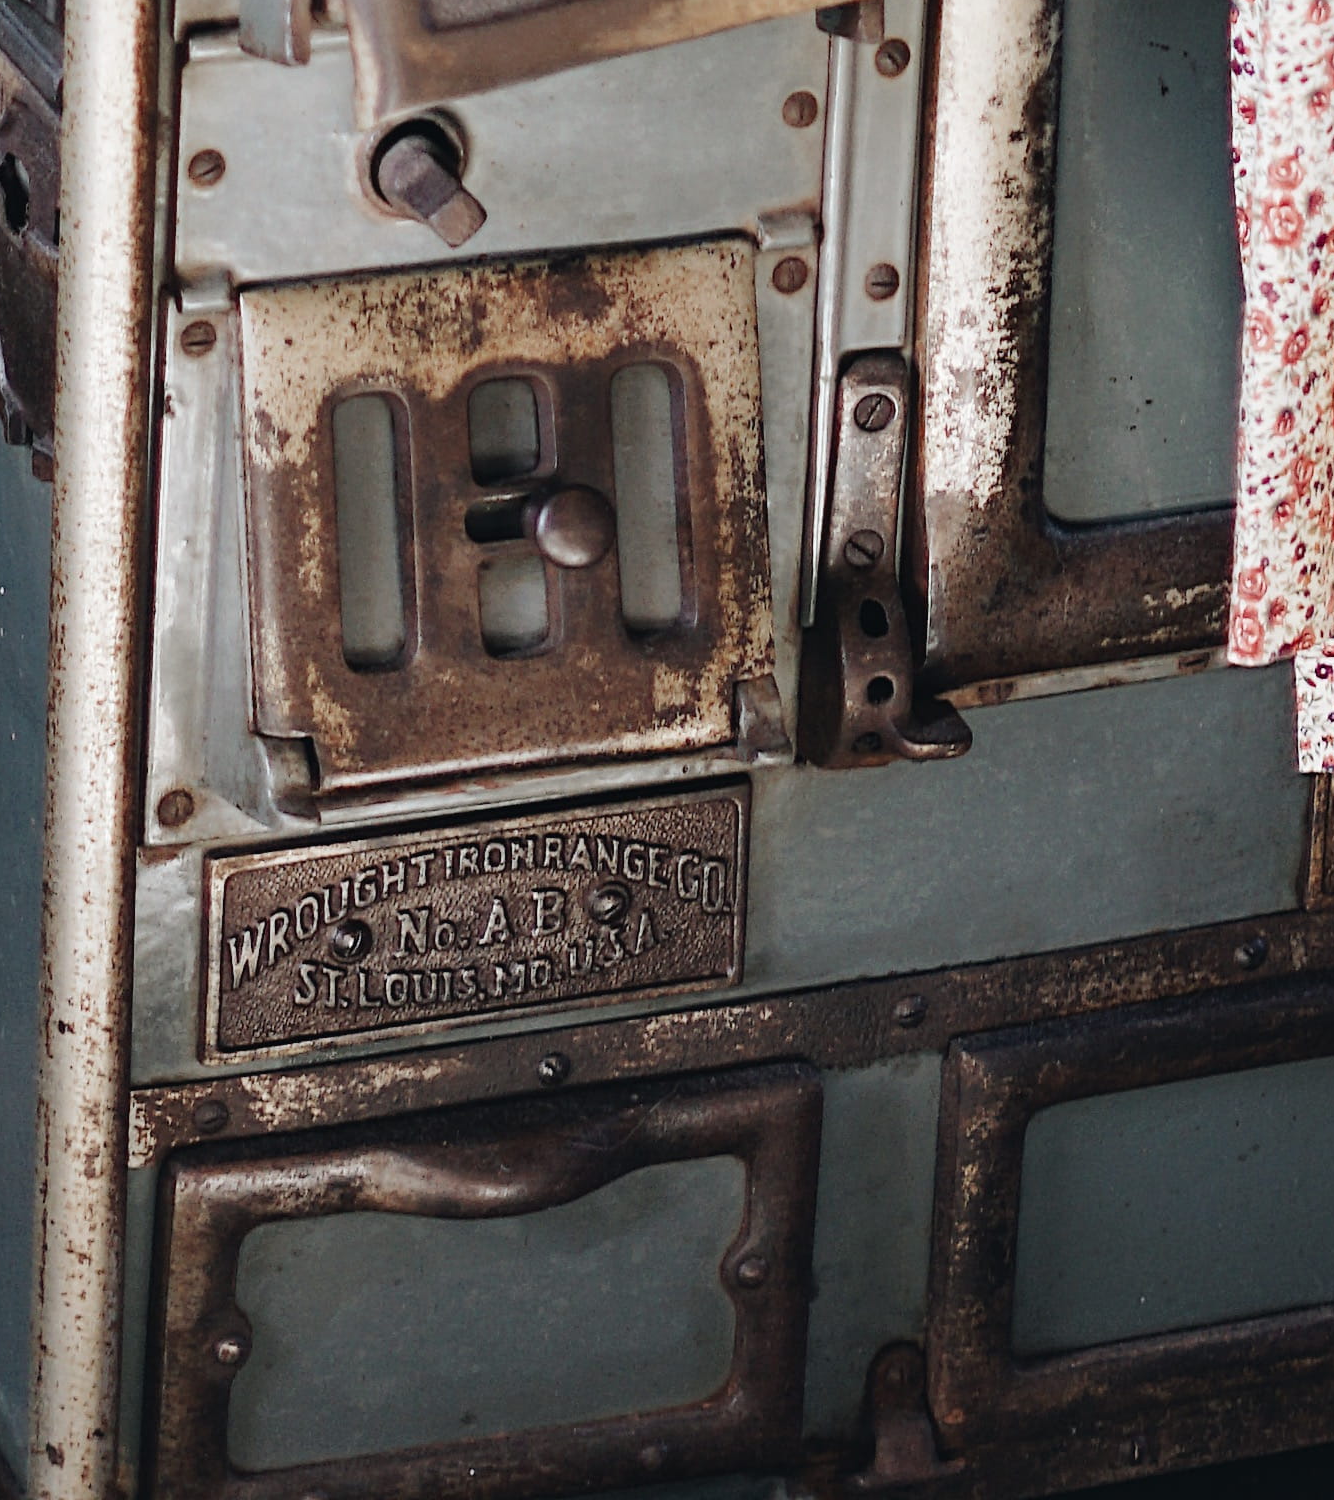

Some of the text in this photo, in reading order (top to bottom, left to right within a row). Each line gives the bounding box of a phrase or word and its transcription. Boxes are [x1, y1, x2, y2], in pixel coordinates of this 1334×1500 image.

[227, 852, 436, 990] WROUGHT
[444, 838, 535, 880] IRON
[543, 836, 670, 890] RANGE
[478, 898, 513, 946] A
[531, 890, 567, 938] B
